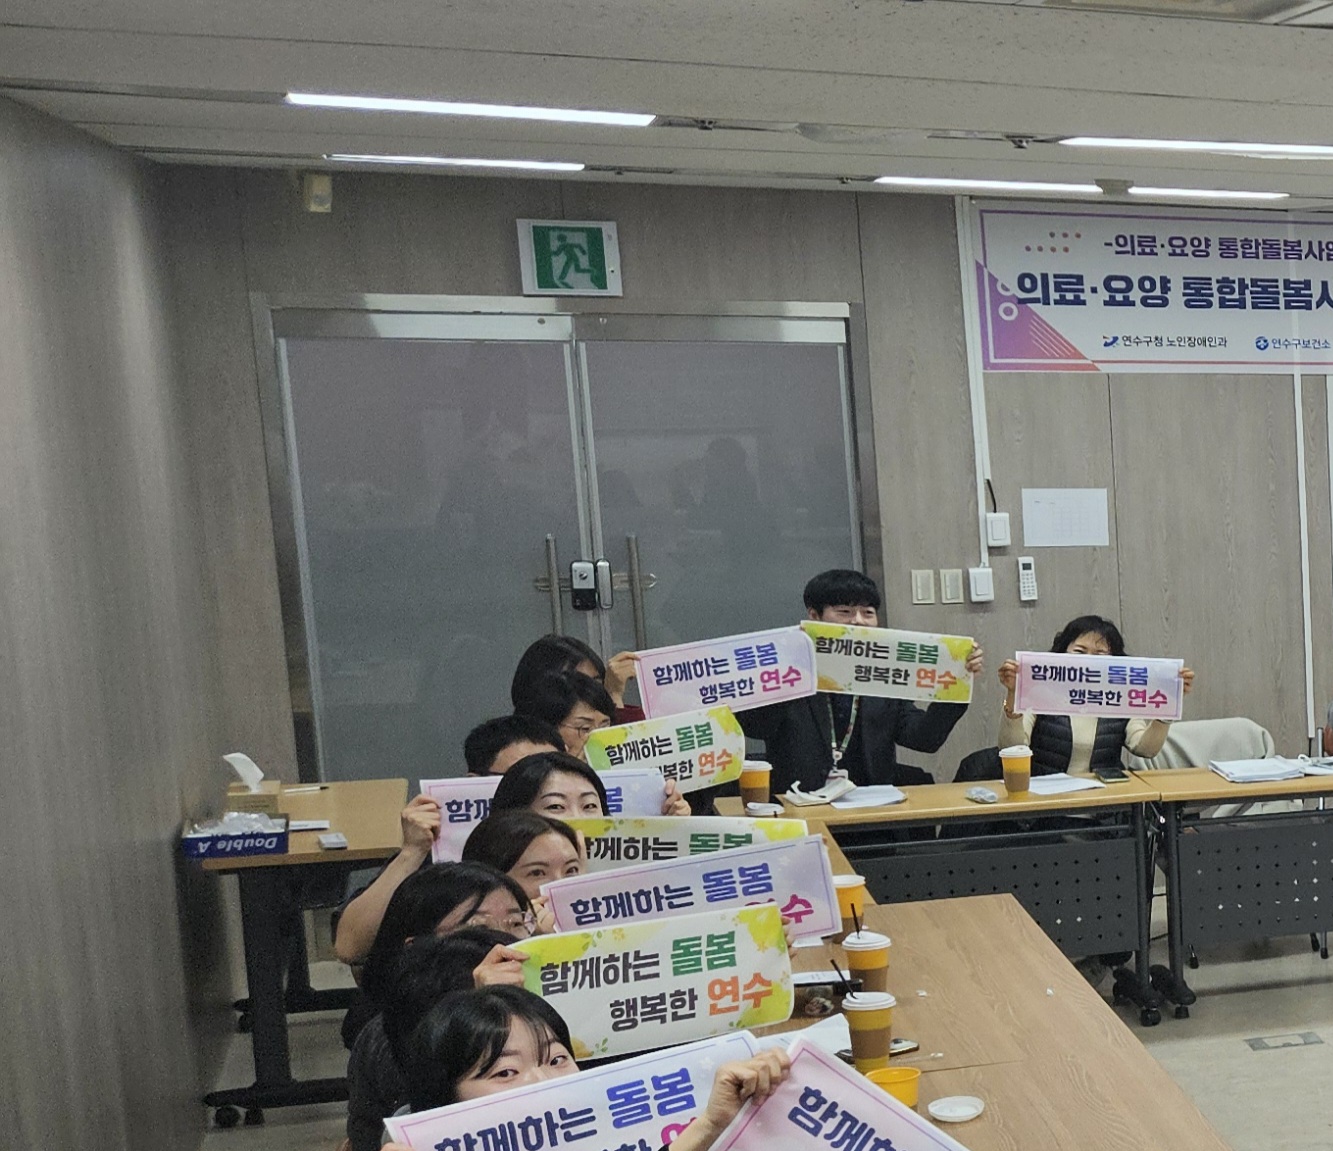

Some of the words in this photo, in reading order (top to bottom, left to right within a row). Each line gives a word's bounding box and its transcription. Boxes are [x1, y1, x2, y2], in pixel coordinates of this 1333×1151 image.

[1017, 272, 1171, 308] 의료·요양
[1122, 335, 1163, 348] 연수구청
[1166, 336, 1227, 348] 노인장애인과
[1271, 338, 1331, 349] 연수구보건소
[653, 656, 732, 687] 함께하는
[733, 643, 778, 671] 돌봄
[816, 635, 889, 661] 함께하는
[895, 641, 939, 665] 돌봄
[699, 675, 755, 704] 행복한
[760, 666, 802, 692] 연수
[854, 663, 909, 687] 행복한
[915, 667, 958, 690] 연수
[1030, 663, 1103, 683] 함께하는
[1107, 664, 1149, 685] 돌봄
[1069, 687, 1122, 706] 행복한
[1127, 688, 1168, 708] 연수
[605, 736, 673, 766] 함께하는
[675, 722, 714, 752] 돌봄
[659, 759, 694, 782] 복한
[698, 748, 733, 777] 연수
[197, 841, 211, 853] A
[217, 837, 277, 851] Double
[570, 885, 694, 926] 함께하는
[702, 862, 773, 903] 돌봄
[540, 950, 660, 996] 함께하는
[670, 930, 737, 977] 돌봄
[610, 988, 698, 1032] 행복한
[707, 970, 773, 1016] 연수
[606, 1067, 696, 1129] 돌봄
